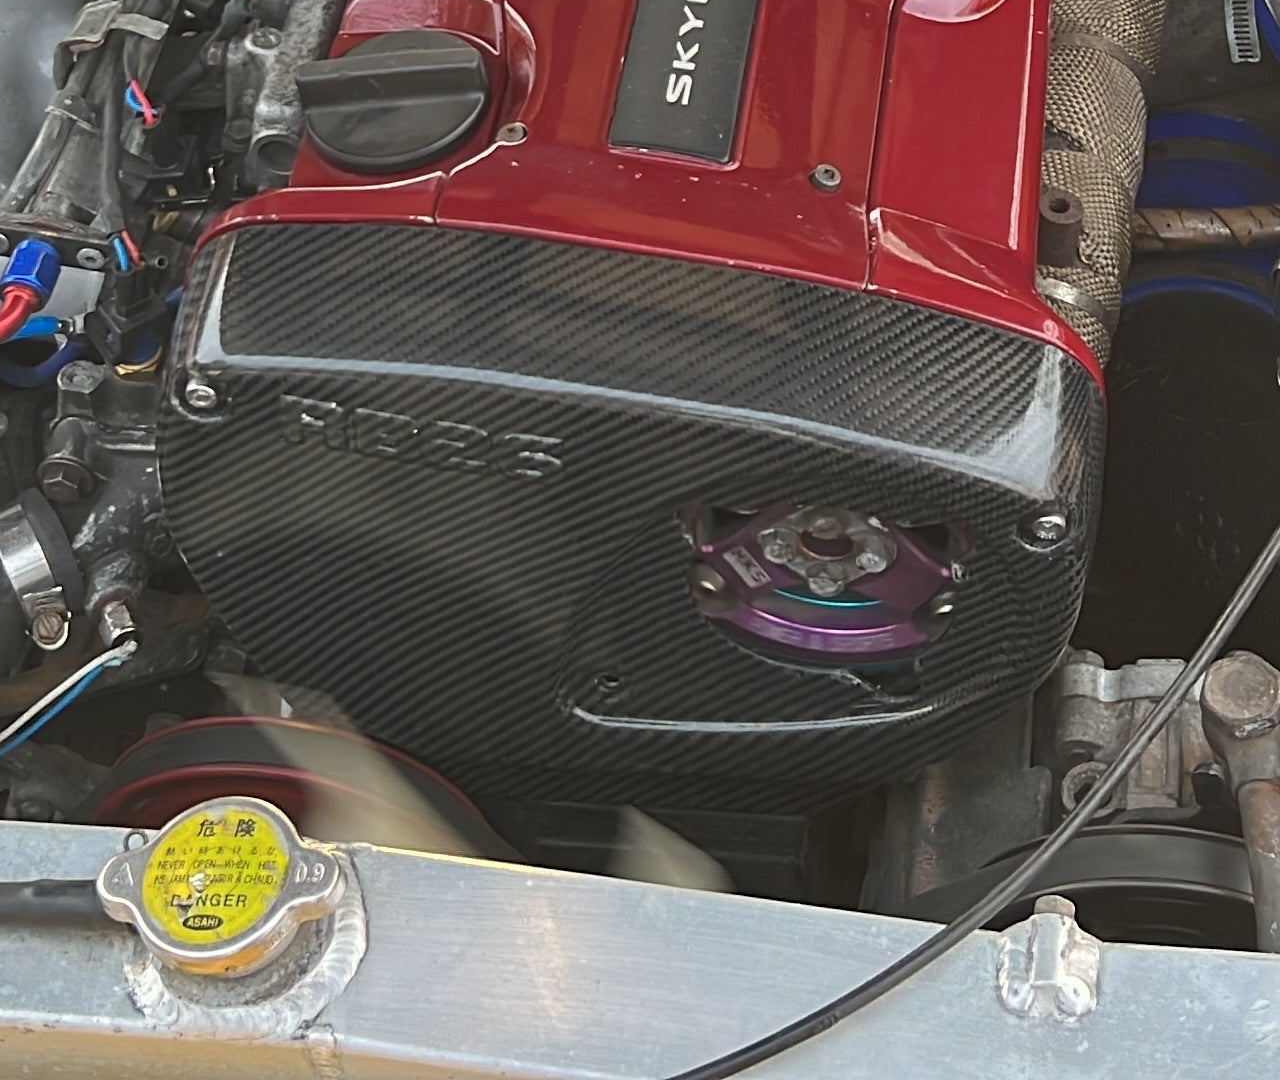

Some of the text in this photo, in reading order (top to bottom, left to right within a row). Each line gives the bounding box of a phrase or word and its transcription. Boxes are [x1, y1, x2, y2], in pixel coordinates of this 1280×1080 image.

[192, 859, 217, 869] OPEN
[295, 860, 325, 883] 0.9
[170, 894, 248, 908] DANGER
[186, 914, 219, 927] ASAHI
